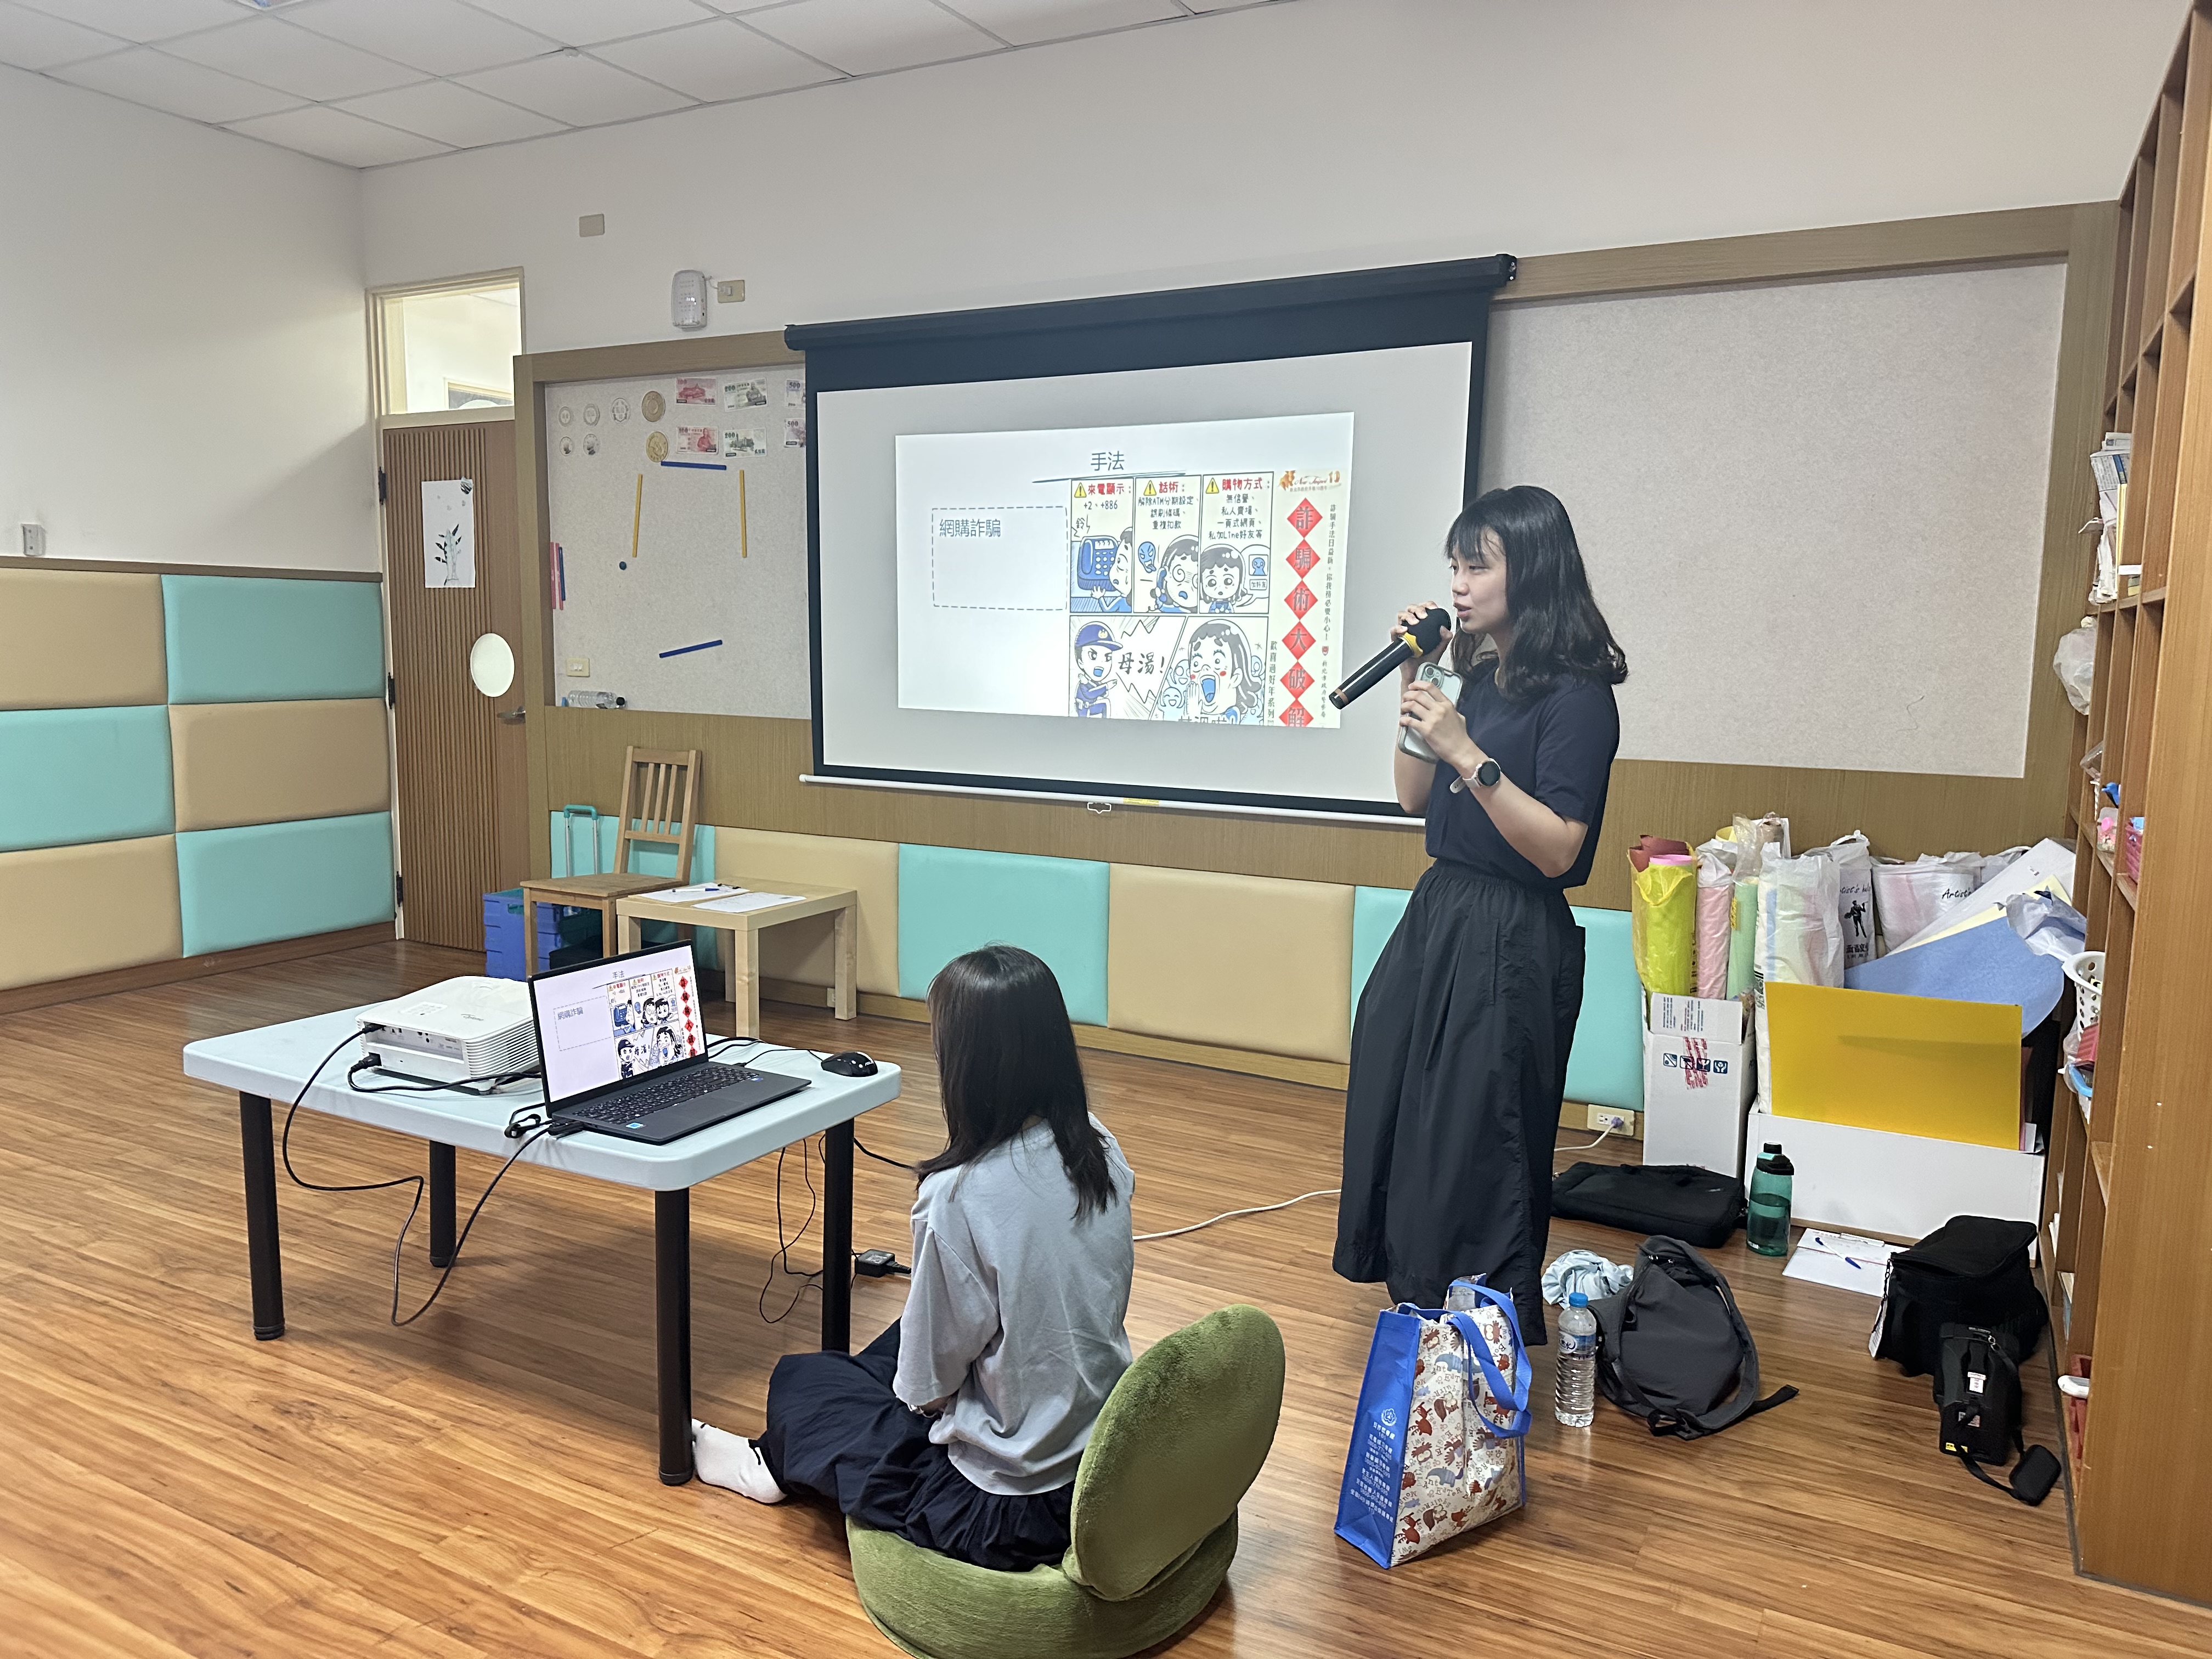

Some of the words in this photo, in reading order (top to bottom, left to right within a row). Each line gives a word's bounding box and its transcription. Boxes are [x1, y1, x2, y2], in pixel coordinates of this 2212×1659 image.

[1091, 451, 1125, 471] 手法
[939, 518, 1001, 537] 網購詐騙
[612, 970, 624, 979] 手法
